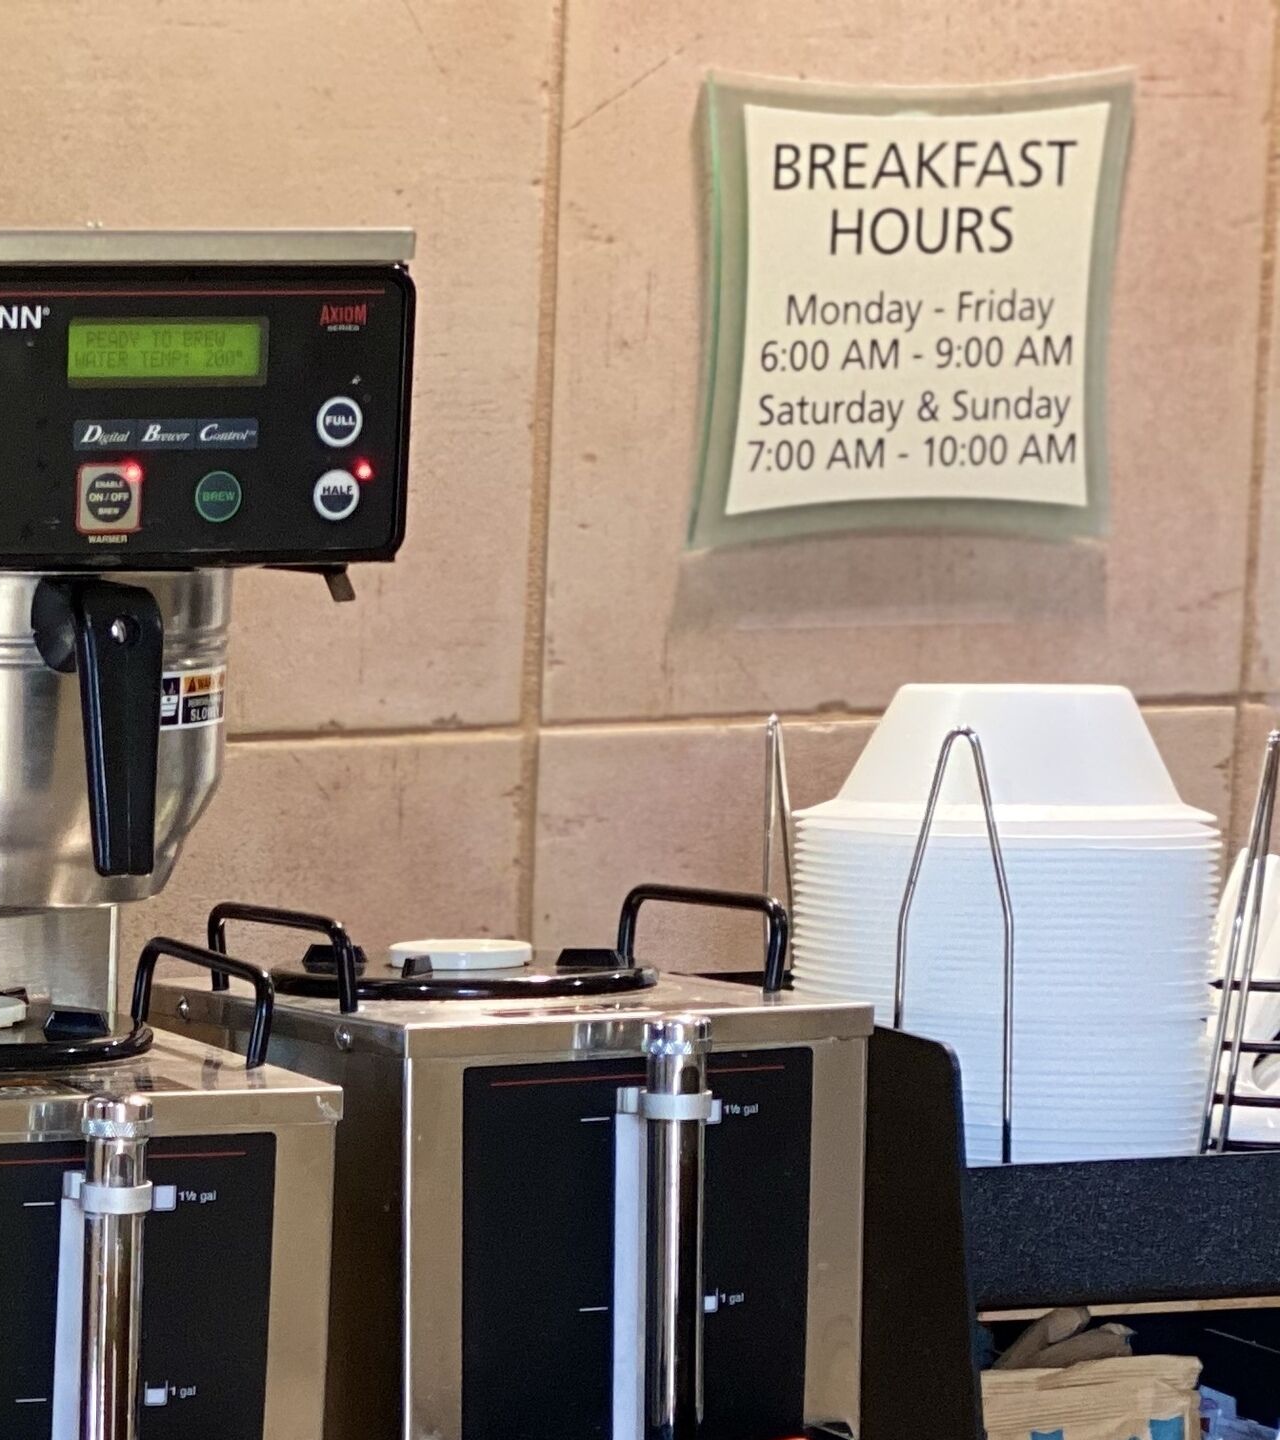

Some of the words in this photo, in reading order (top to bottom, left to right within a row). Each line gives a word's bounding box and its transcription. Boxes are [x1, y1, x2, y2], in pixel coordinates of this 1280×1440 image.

[772, 140, 1078, 190] BREAKFAST
[829, 206, 1014, 255] HOURS
[320, 304, 367, 326] AXIOM
[785, 291, 922, 331] Monday
[957, 288, 1054, 330] Friday
[153, 330, 172, 347] TO
[74, 351, 129, 368] WATER
[760, 340, 830, 372] 6:00
[840, 338, 900, 371] AM
[935, 336, 1005, 369] 9:00
[1014, 335, 1073, 366] AM
[758, 390, 904, 432] Saturday
[917, 390, 939, 421] &
[952, 386, 1071, 427] Sunday
[325, 415, 356, 426] FULL
[748, 440, 815, 472] 7:00
[826, 438, 886, 470] AM
[925, 434, 1008, 467] 10:00
[1018, 432, 1077, 465] AM
[202, 491, 235, 502] BREW
[322, 485, 353, 496] HALF
[88, 535, 128, 544] WARMER
[744, 1103, 758, 1117] gal
[200, 1190, 217, 1204] gal
[729, 1292, 744, 1306] gal
[180, 1385, 196, 1399] gal
